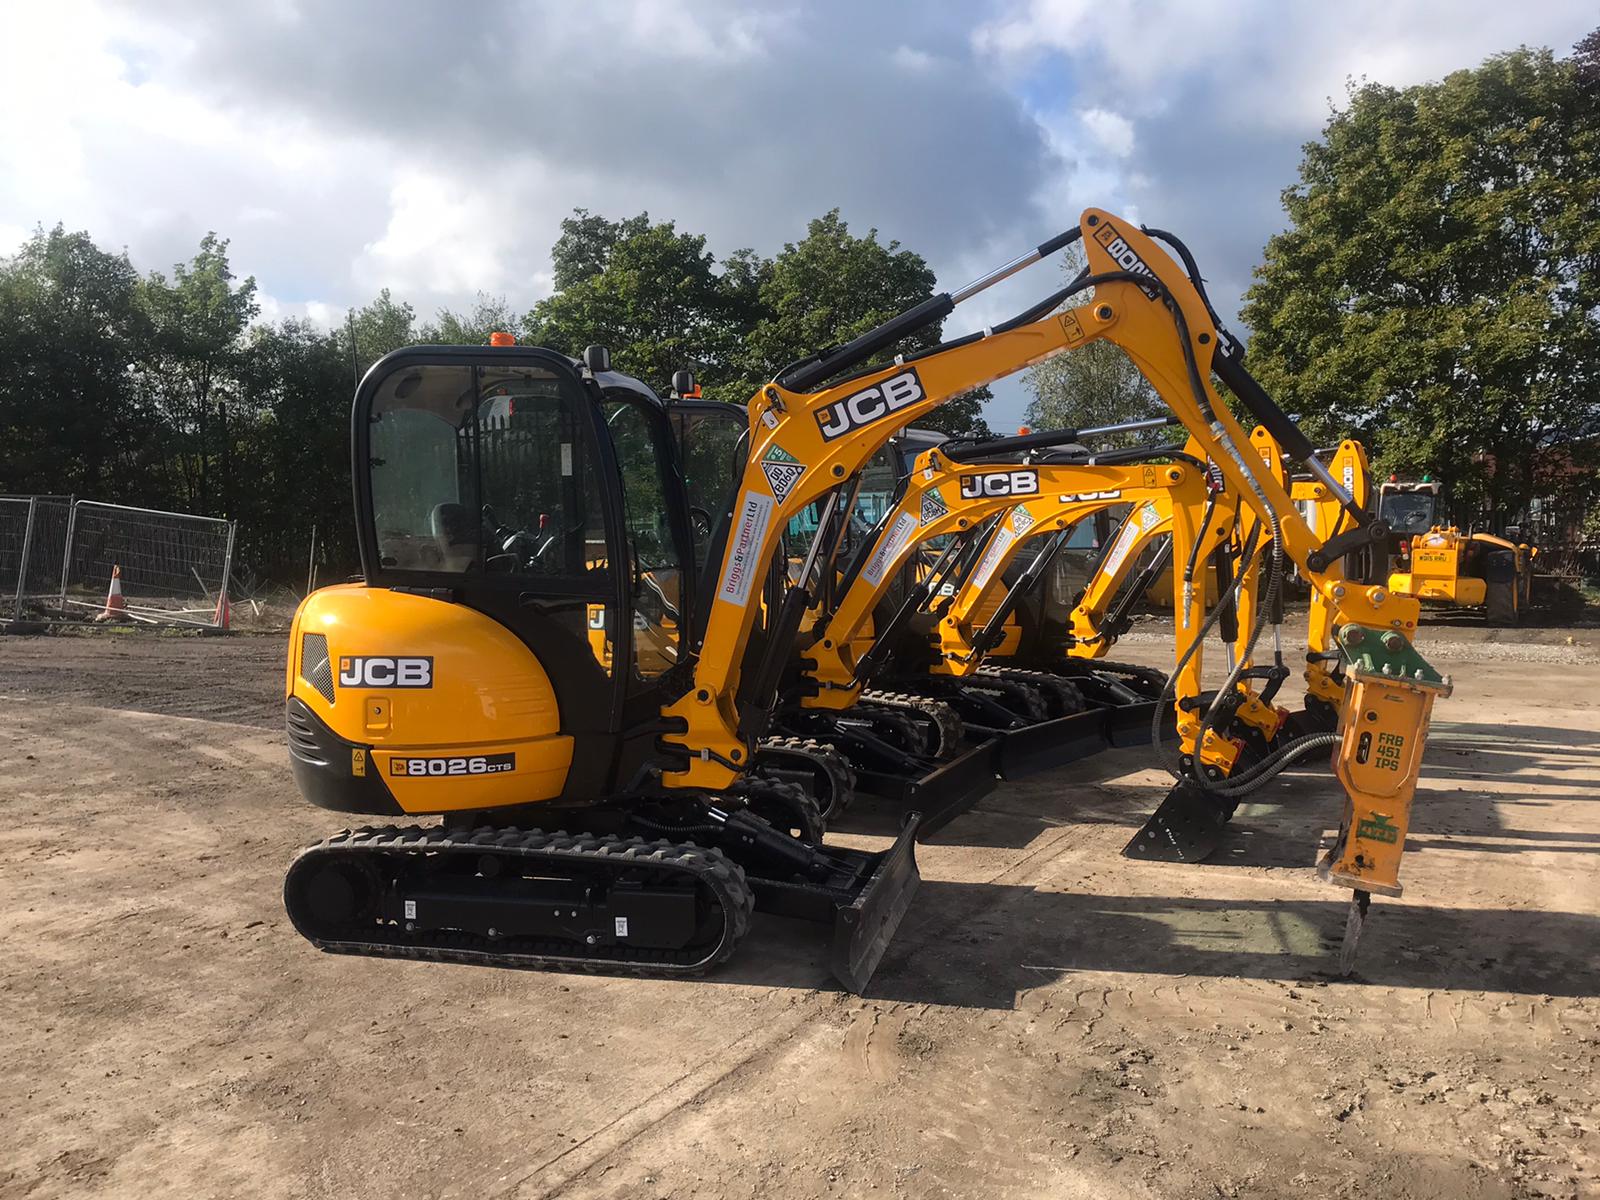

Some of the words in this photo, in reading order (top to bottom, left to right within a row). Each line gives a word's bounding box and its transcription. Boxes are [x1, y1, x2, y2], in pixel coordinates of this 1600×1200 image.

[822, 372, 922, 438] JCB
[961, 471, 1038, 498] JCB
[340, 658, 431, 686] JCB
